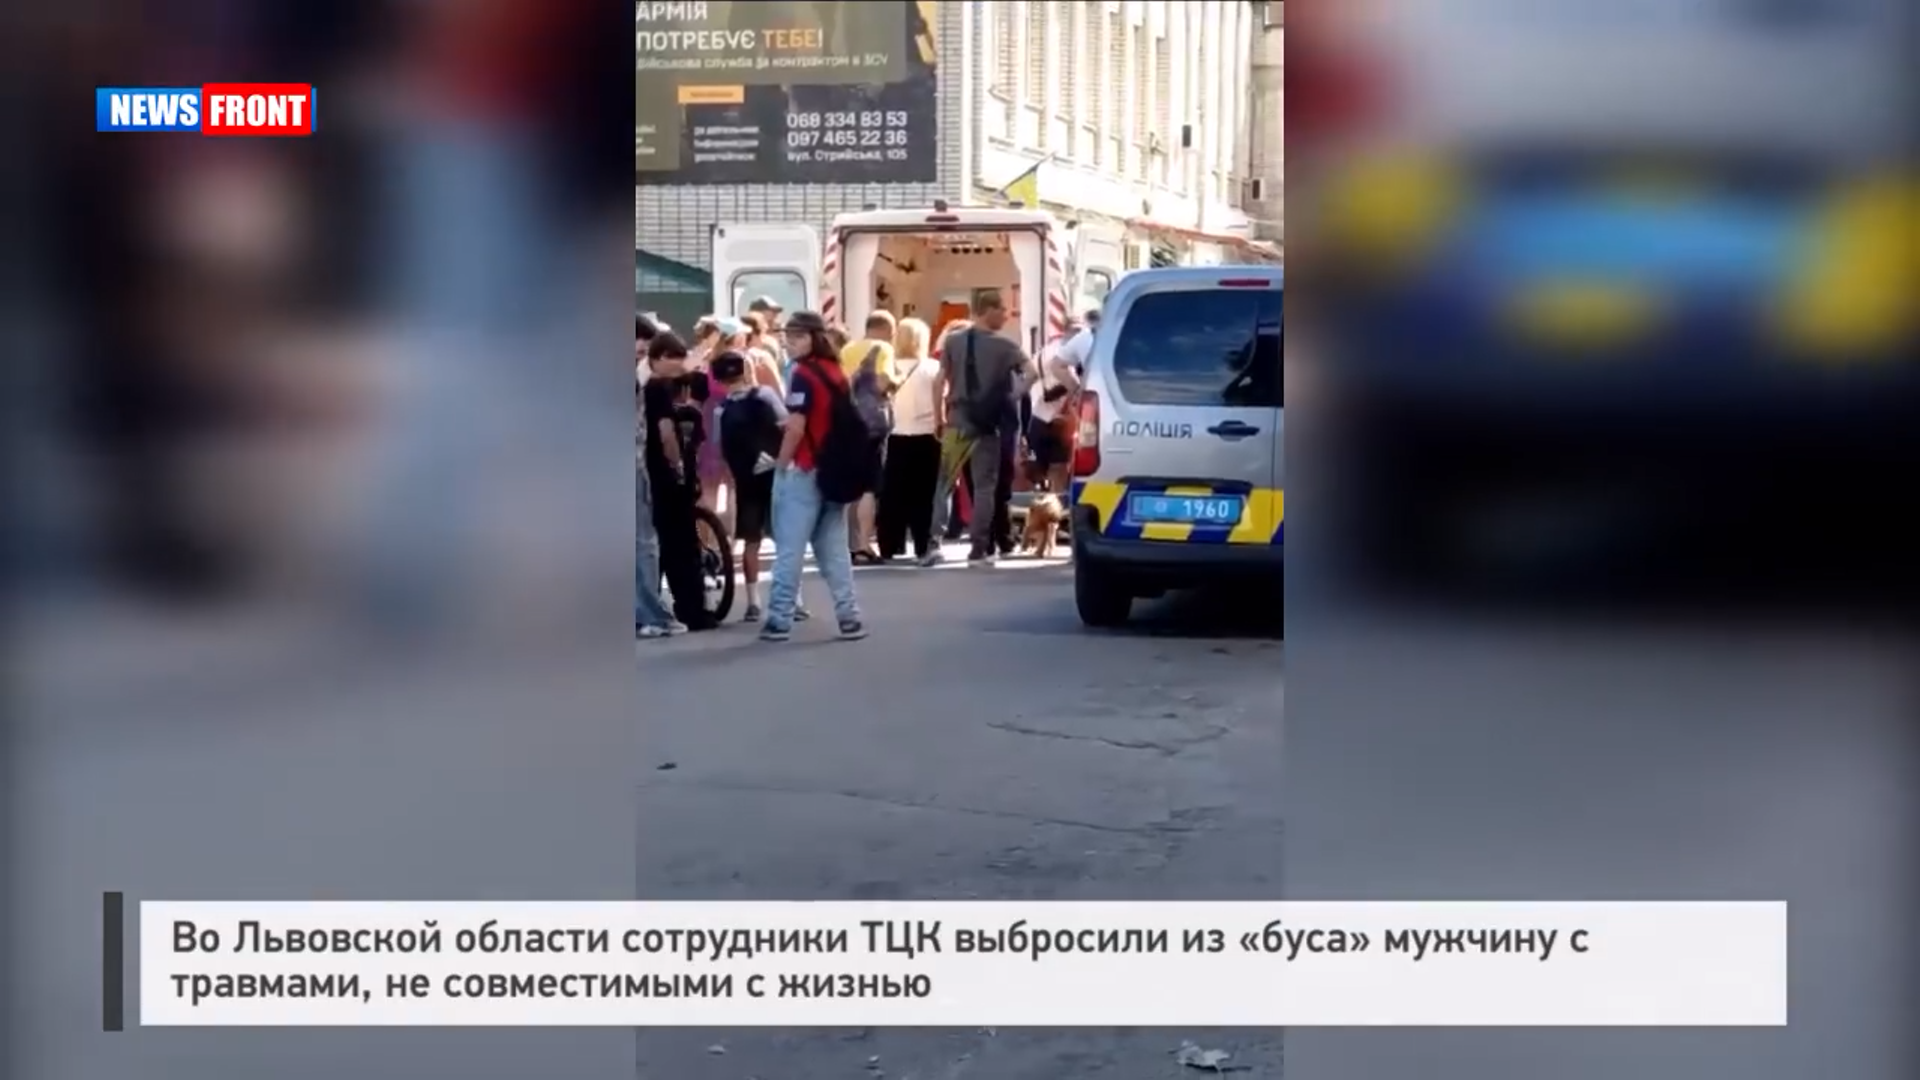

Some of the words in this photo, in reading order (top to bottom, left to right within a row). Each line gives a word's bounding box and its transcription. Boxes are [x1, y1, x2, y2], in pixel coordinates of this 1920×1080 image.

[636, 1, 708, 21] АРМІЯ
[636, 29, 756, 51] ПОТРЕБУЄ
[761, 28, 824, 49] ТЕБЕ!
[823, 111, 857, 128] 334
[860, 110, 883, 127] 83
[885, 110, 908, 127] 53
[786, 130, 820, 147] 097
[822, 129, 857, 146] 465
[859, 129, 882, 146] 22
[884, 129, 908, 146] 36
[886, 148, 908, 160] 105
[1112, 420, 1193, 439] ПОЛІЦІЯ
[1182, 499, 1229, 519] 1960
